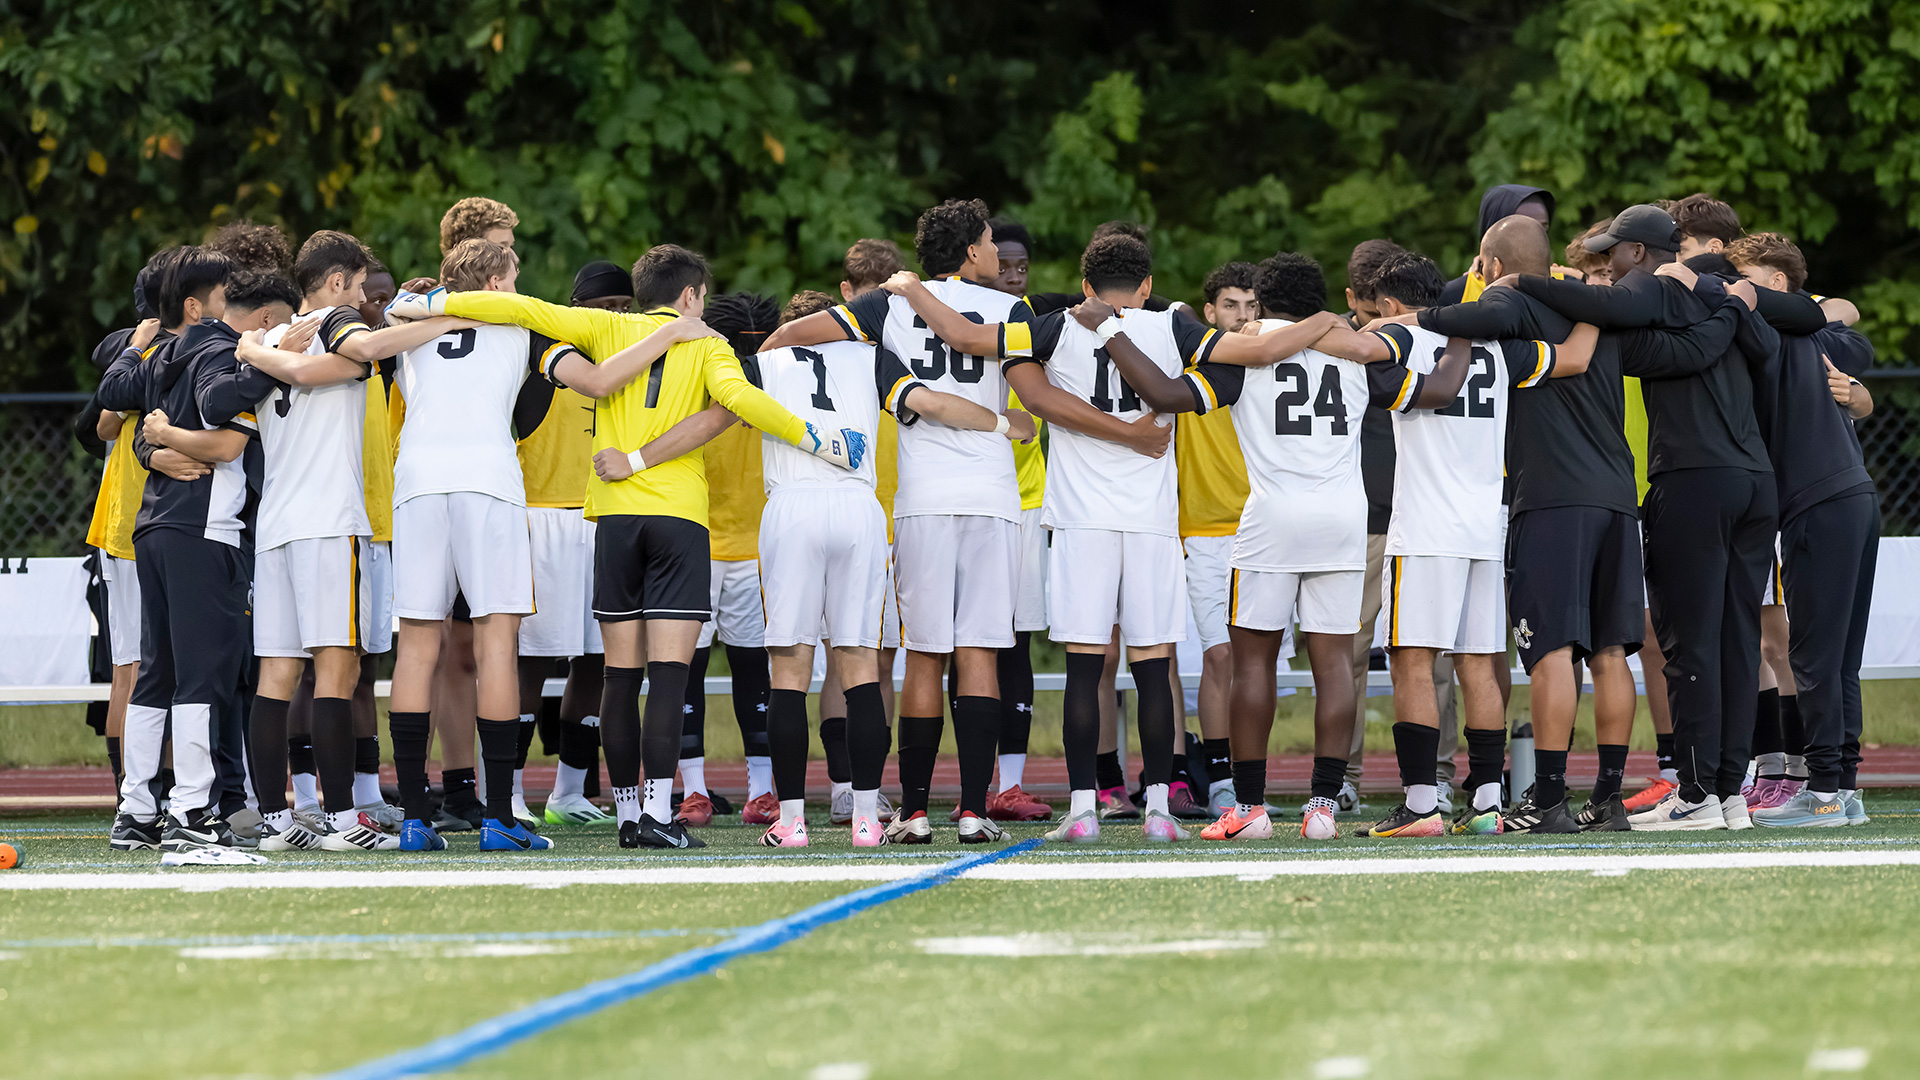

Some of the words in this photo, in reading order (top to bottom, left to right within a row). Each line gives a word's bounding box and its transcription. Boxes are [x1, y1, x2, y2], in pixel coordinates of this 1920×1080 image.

[791, 346, 837, 412] 7
[1090, 344, 1142, 413] 11
[1275, 362, 1349, 436] 24
[1815, 803, 1841, 816] HOKA
